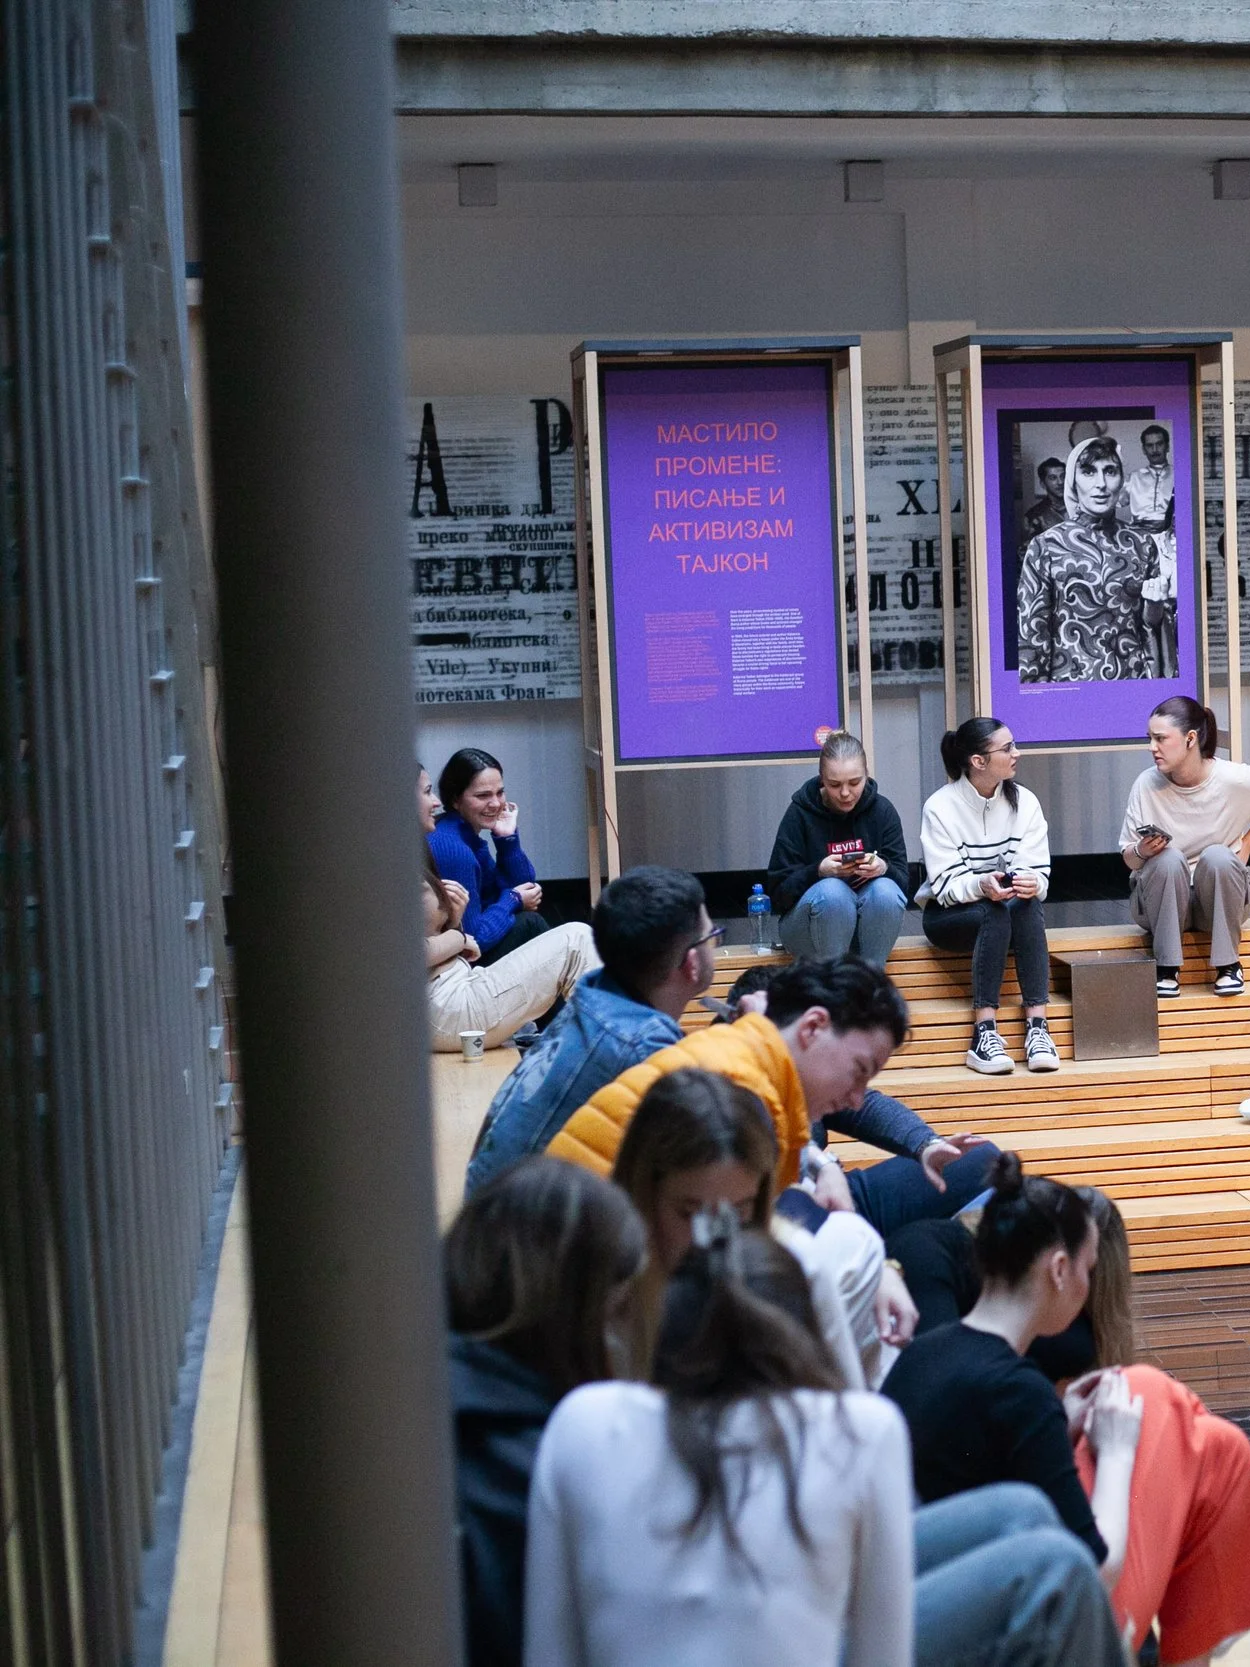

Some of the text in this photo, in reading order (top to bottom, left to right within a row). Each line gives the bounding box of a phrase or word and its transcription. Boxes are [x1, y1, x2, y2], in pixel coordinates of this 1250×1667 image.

[657, 422, 778, 444] МАСТИЛО
[655, 455, 781, 476] ПРОМЕНЕ:
[655, 487, 785, 509] ПИСАЊЕ И
[649, 519, 793, 542] АКТИВИЗАМ
[676, 552, 768, 574] ТАЈКОН
